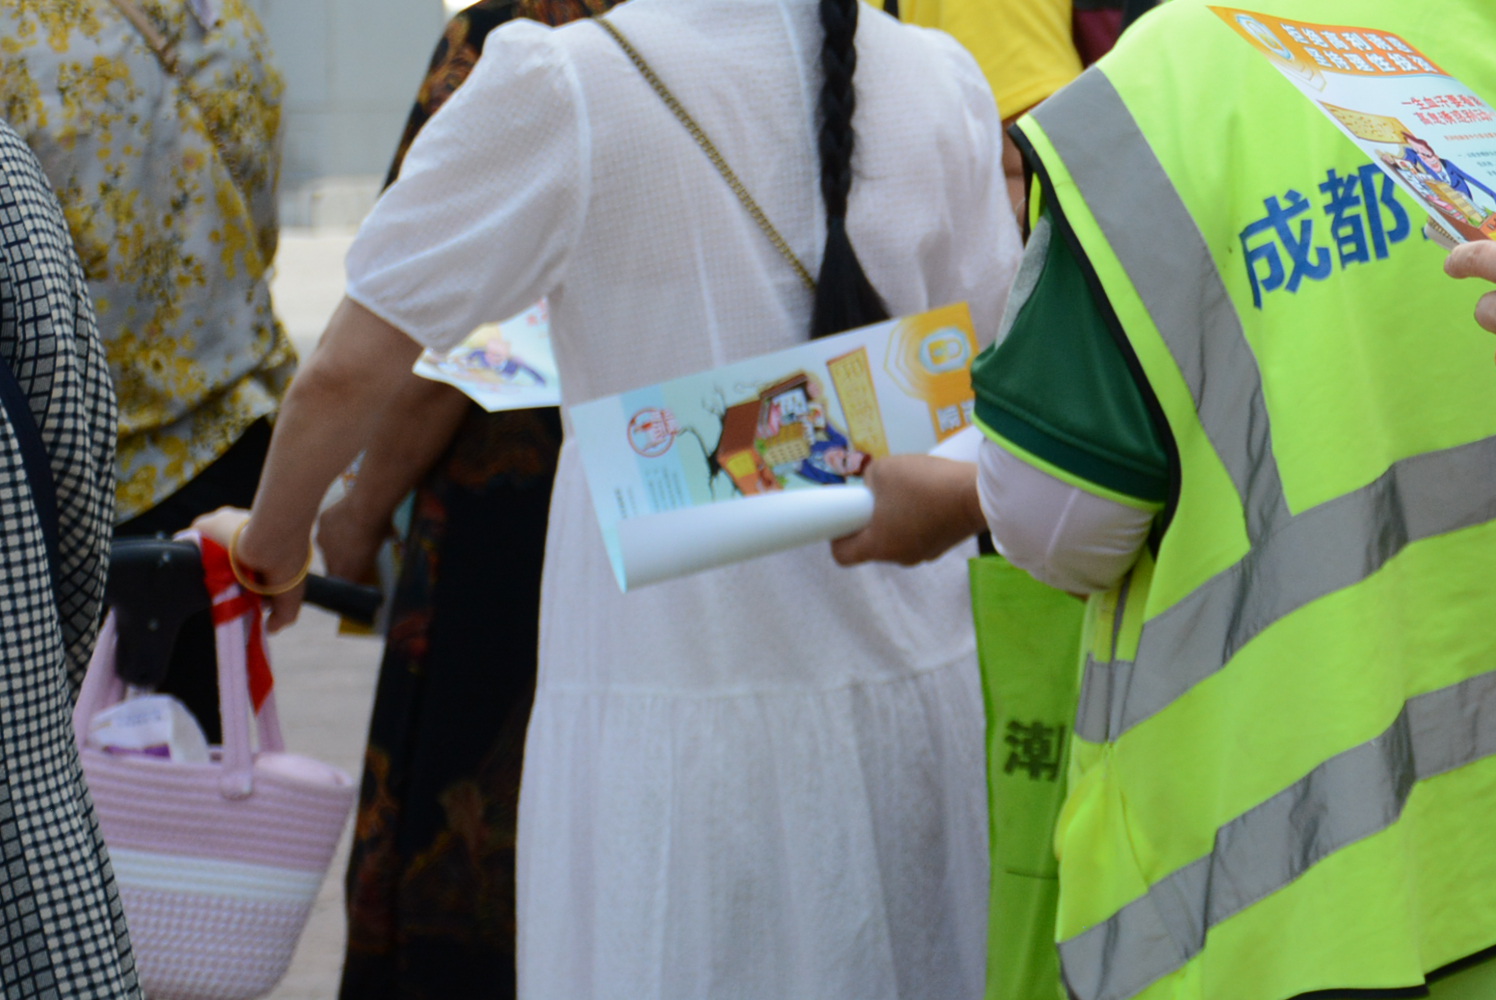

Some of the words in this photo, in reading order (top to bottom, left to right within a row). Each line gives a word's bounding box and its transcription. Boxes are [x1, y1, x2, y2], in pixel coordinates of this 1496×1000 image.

[1280, 23, 1414, 53] 拒绝高利诱惑
[1303, 46, 1439, 73] 坚持理性投资
